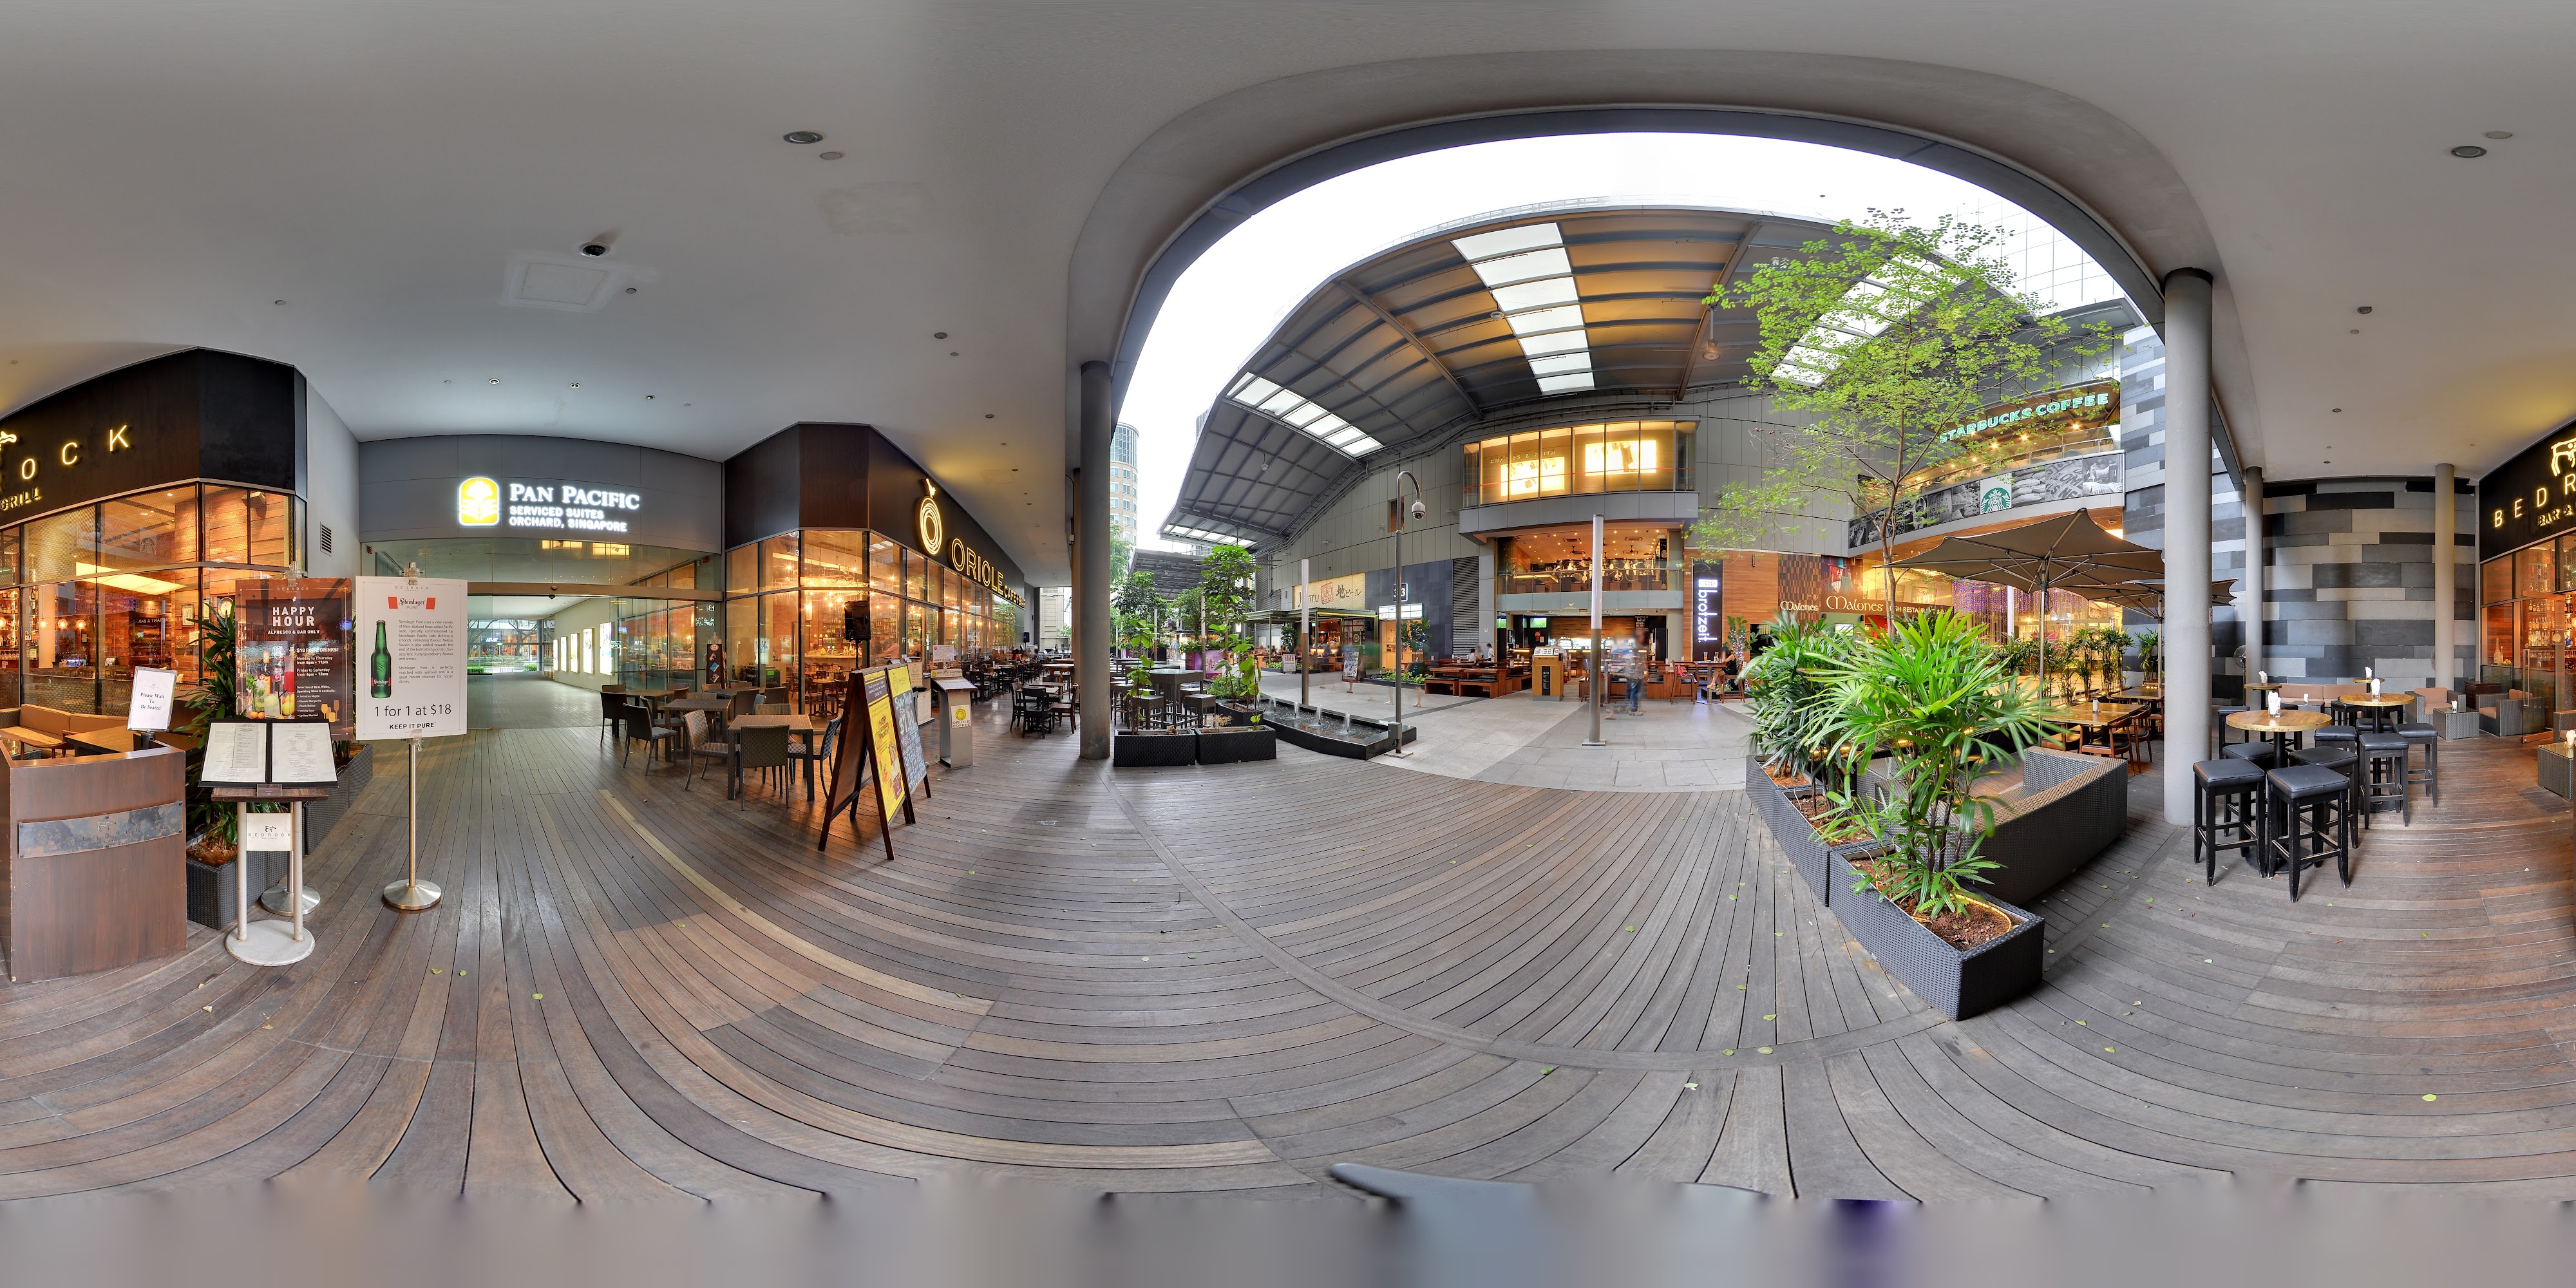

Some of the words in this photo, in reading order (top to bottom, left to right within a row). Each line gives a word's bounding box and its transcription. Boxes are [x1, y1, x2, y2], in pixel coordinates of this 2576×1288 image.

[1939, 408, 2032, 443] STARBUCKS
[2035, 393, 2109, 416] COFFEE
[0, 488, 41, 511] GRILL
[509, 484, 554, 502] PAN
[562, 486, 640, 510] PACIFIC
[509, 506, 564, 517] SERVICED
[566, 508, 604, 519] SUITES
[2538, 509, 2561, 527] BAR
[2563, 504, 2573, 516] &
[509, 516, 564, 529] ORCHARD,
[567, 518, 627, 532] SINGAPORE
[952, 538, 1003, 595] ORIOLE
[1336, 584, 1362, 600] 地ビール
[399, 598, 425, 606] Steinlager
[1780, 601, 1819, 612] Malones
[1826, 596, 1884, 612] Malones
[272, 607, 315, 616] HAPPY
[272, 616, 315, 627] HOUR
[375, 706, 379, 717] 1
[384, 705, 401, 717] for
[406, 706, 410, 716] 1
[415, 706, 427, 715] at
[431, 703, 451, 715] $18
